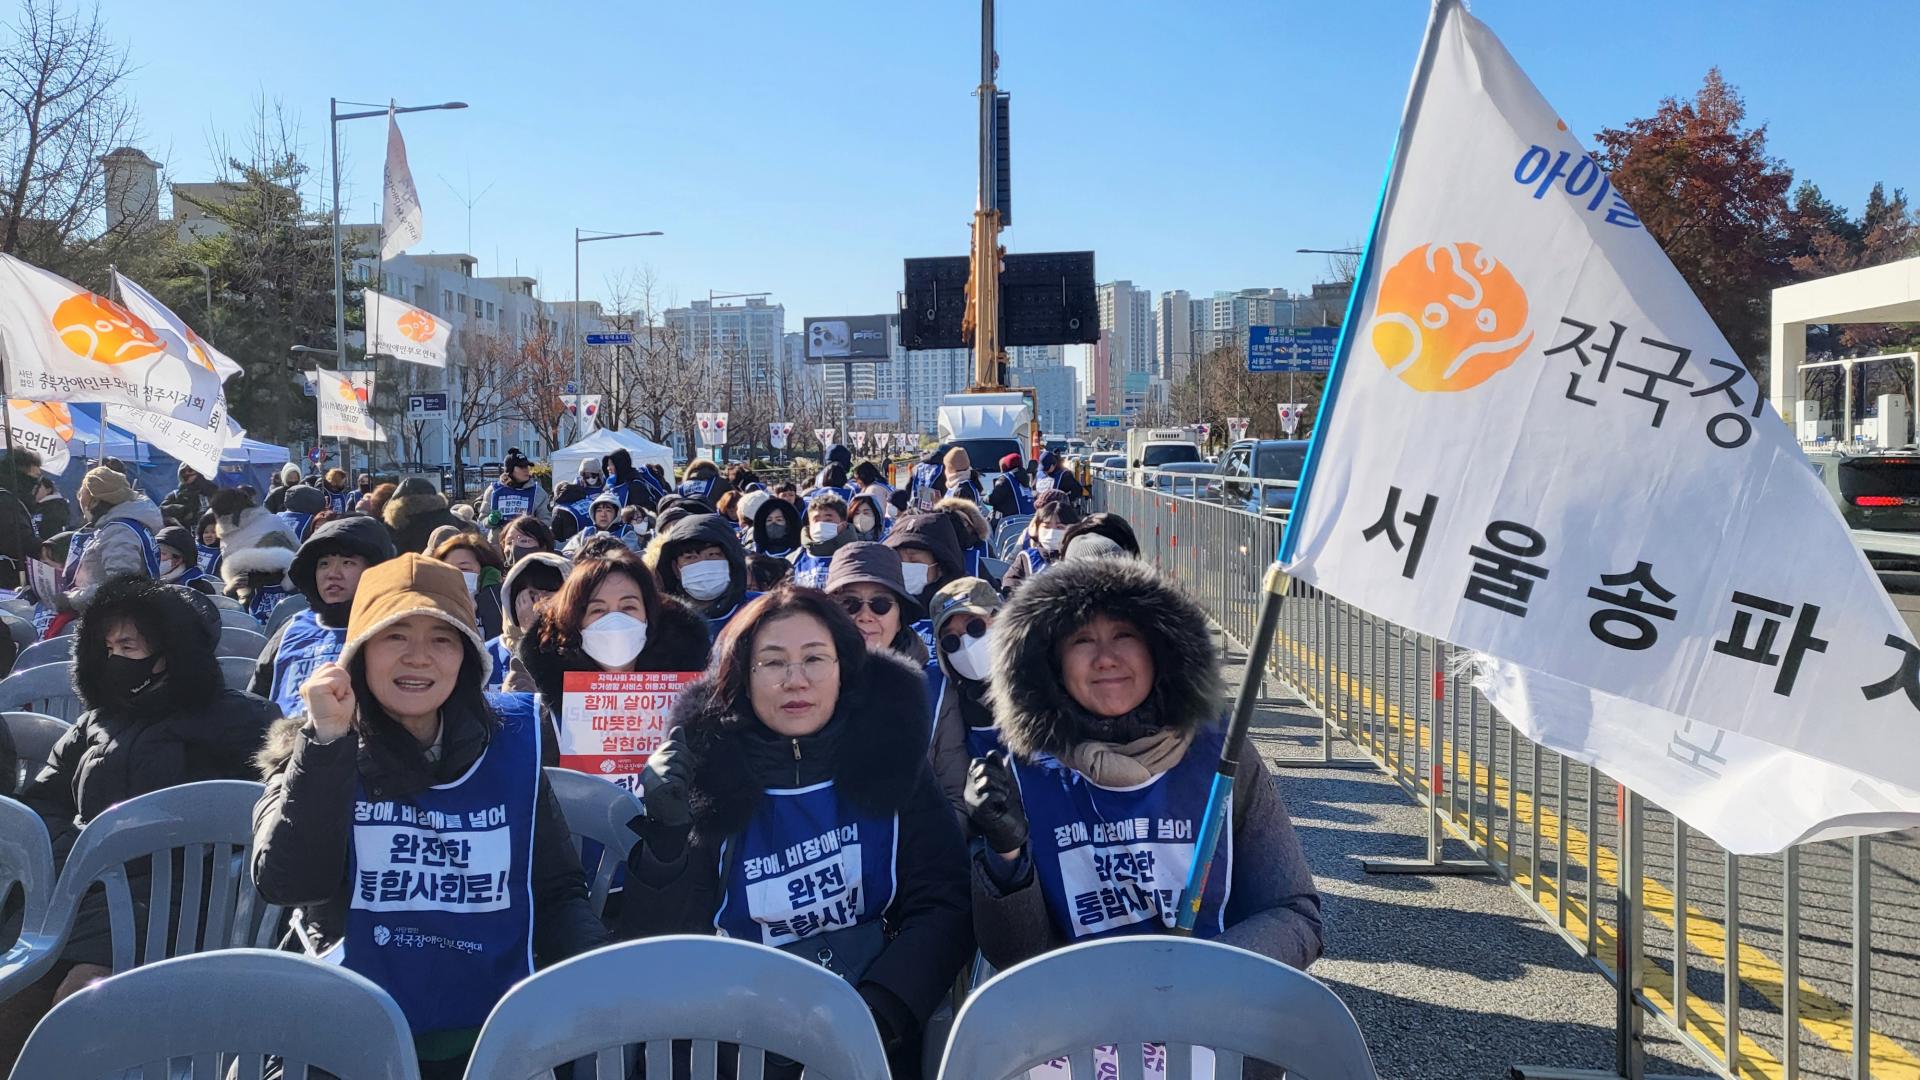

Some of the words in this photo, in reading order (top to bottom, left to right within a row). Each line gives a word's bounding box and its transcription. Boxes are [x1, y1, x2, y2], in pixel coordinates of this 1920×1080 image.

[853, 332, 883, 340] PRO
[142, 385, 206, 412] 청주시지회
[411, 399, 422, 412] P
[585, 695, 617, 711] 함께
[624, 695, 678, 711] 살아가
[592, 715, 642, 731] 따뜻한
[647, 715, 664, 731] 사
[354, 801, 399, 822] 장애,
[468, 804, 506, 828] 넘어
[1157, 818, 1192, 840] 넘어
[390, 833, 472, 869] 완전한
[743, 852, 786, 881] 장애,
[1094, 850, 1156, 884] 완전한
[360, 870, 507, 904] 통합사회로!
[787, 862, 847, 911] 완전
